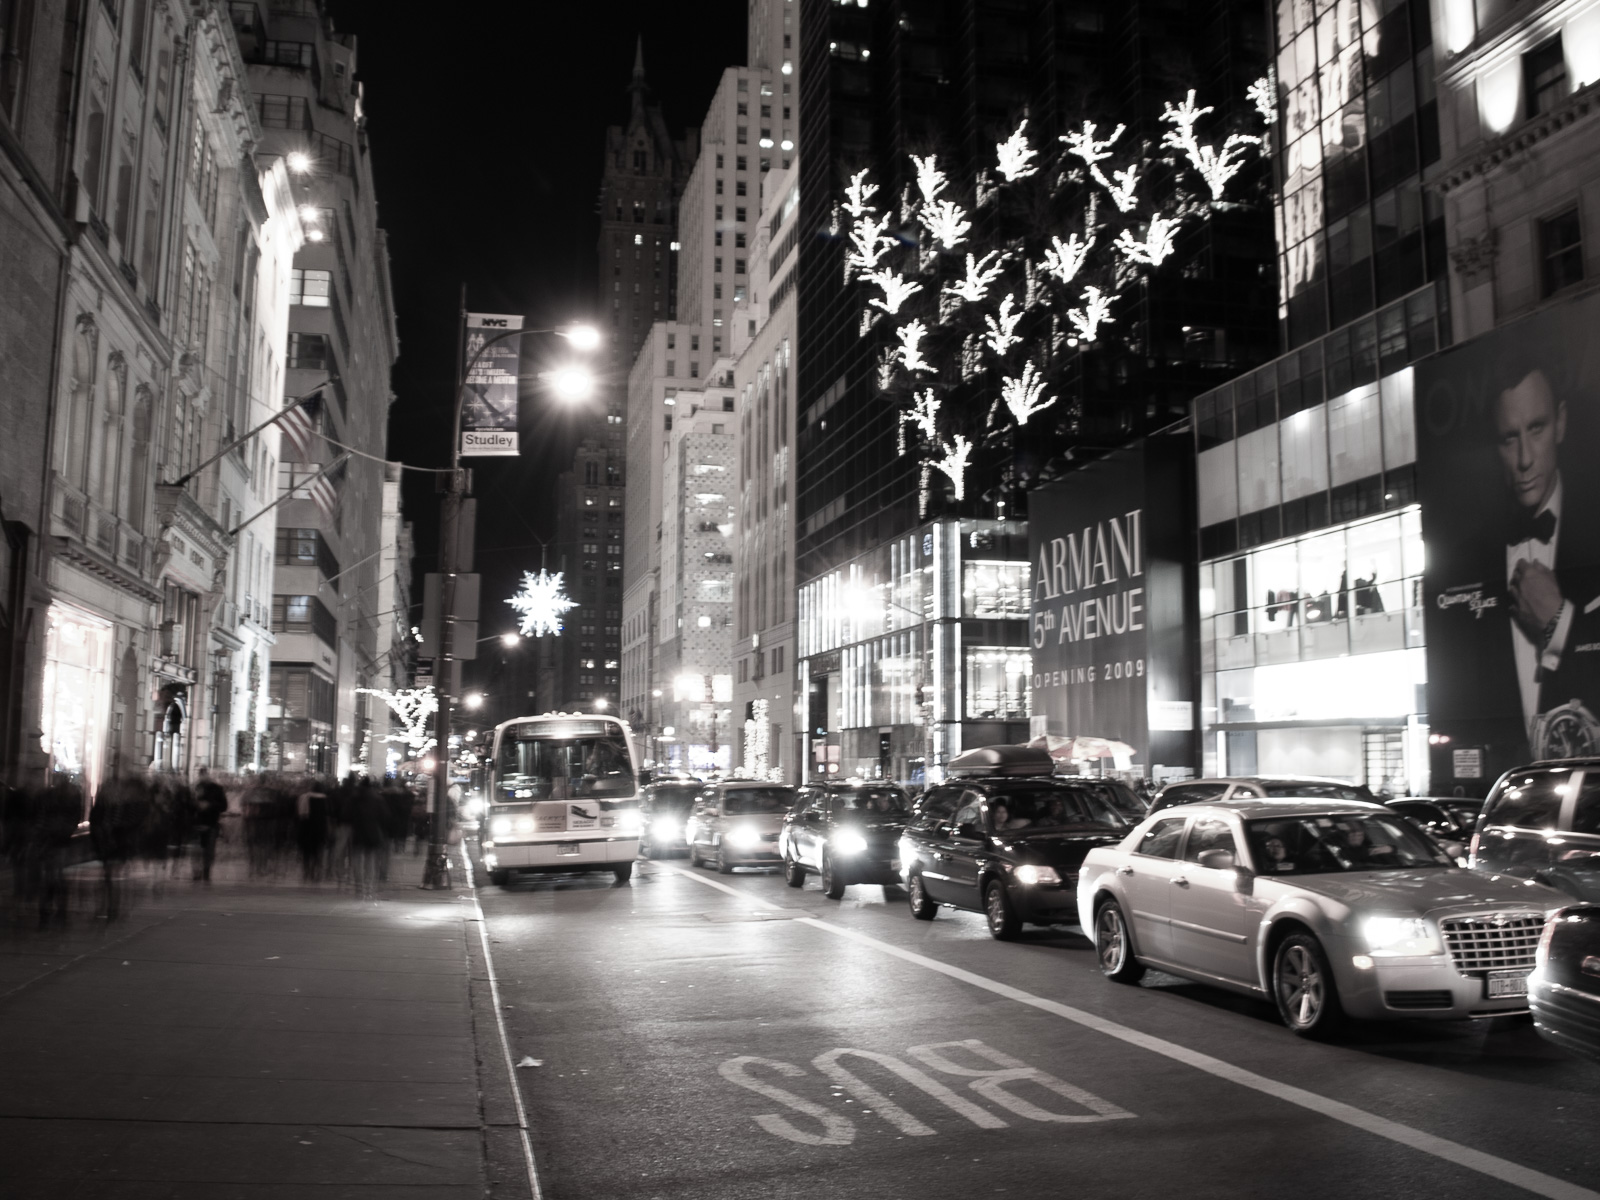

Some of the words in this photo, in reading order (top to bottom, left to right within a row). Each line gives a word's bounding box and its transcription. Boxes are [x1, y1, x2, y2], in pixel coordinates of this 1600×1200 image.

[482, 318, 507, 327] NYC
[465, 434, 513, 447] Studley
[1034, 509, 1143, 603] ARMANI
[1033, 609, 1056, 649] 5th
[1059, 587, 1145, 645] AVENUE
[1034, 666, 1096, 689] OPENING
[1104, 659, 1145, 680] 2009
[718, 1038, 1138, 1146] BUS
